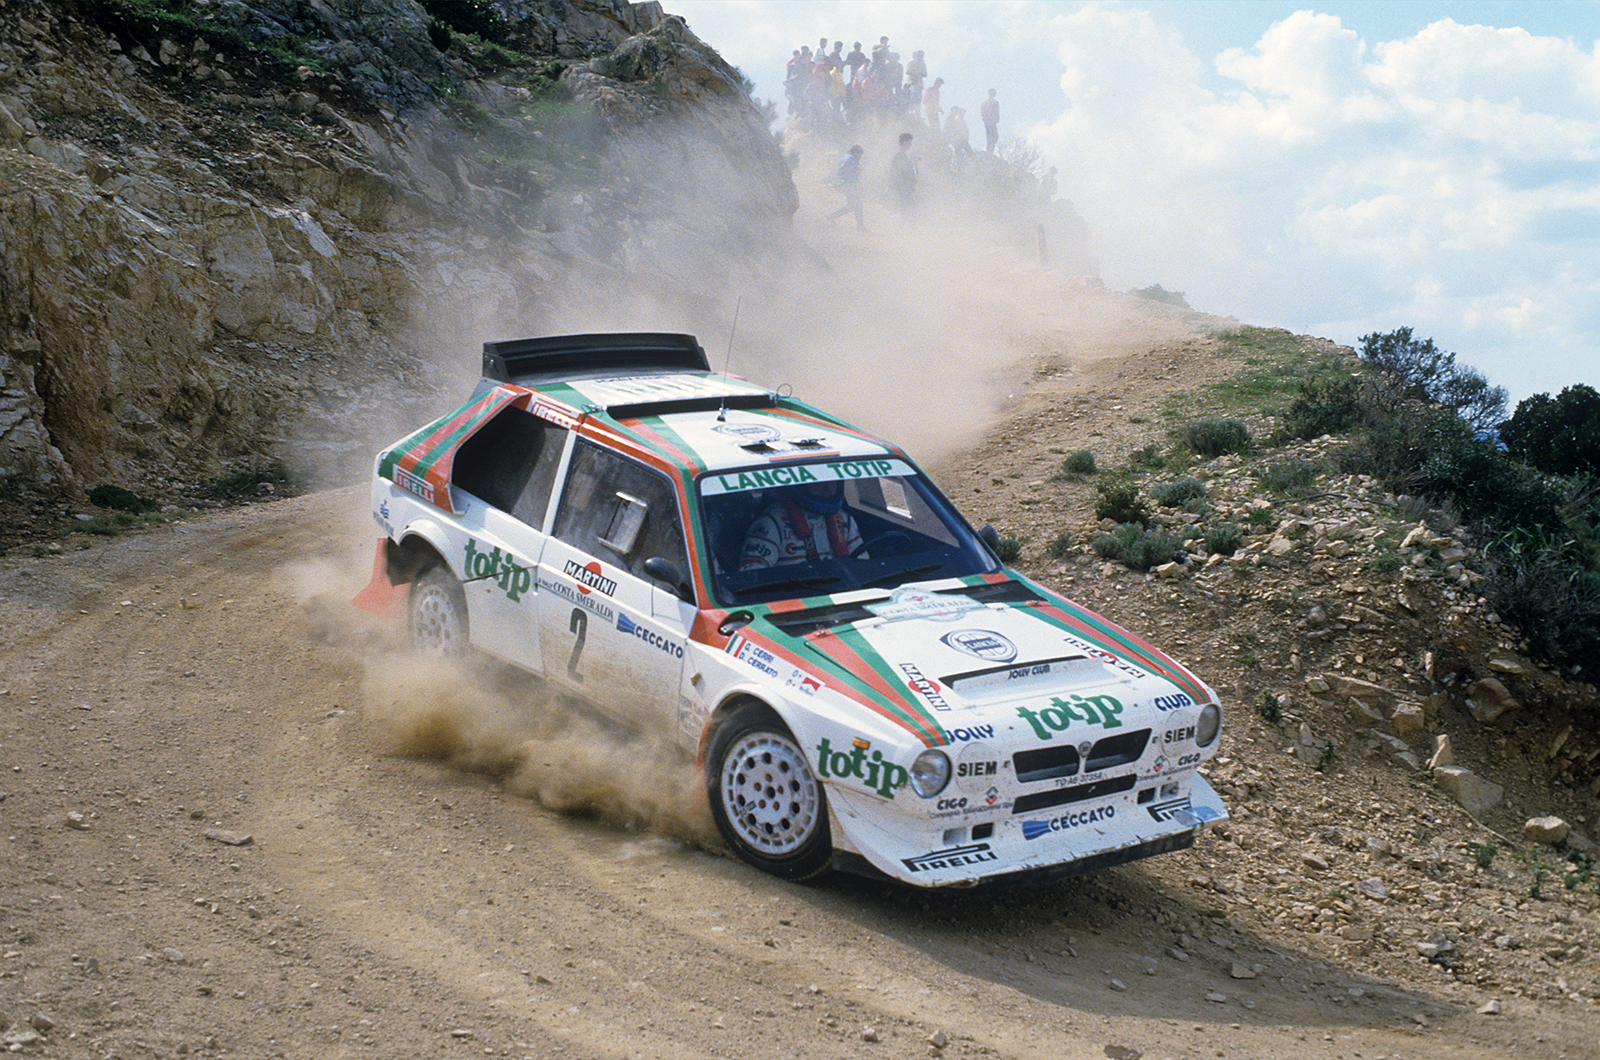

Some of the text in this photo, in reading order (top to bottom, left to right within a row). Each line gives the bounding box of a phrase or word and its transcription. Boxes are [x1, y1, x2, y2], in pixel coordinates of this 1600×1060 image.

[525, 393, 580, 430] PIRELLI
[392, 463, 435, 503] PIRELLI
[718, 460, 893, 492] LANCIA TOTIP
[464, 537, 531, 604] totip
[564, 560, 617, 597] MARTINI
[567, 607, 588, 685] 2
[635, 625, 685, 660] CECCATO
[753, 647, 775, 664] CERRI
[747, 656, 779, 678] CERRATO
[1008, 664, 1051, 680] JOLLY CLUB
[899, 662, 952, 712] MARTINI
[1153, 693, 1192, 712] CLUB
[946, 724, 994, 743] JOLLY
[1015, 694, 1123, 741] totip
[1164, 725, 1196, 744] SIEM
[816, 736, 909, 800] totip
[957, 761, 998, 778] SIEM
[1050, 805, 1115, 832] CECCATO
[900, 842, 998, 873] PIRELLI
